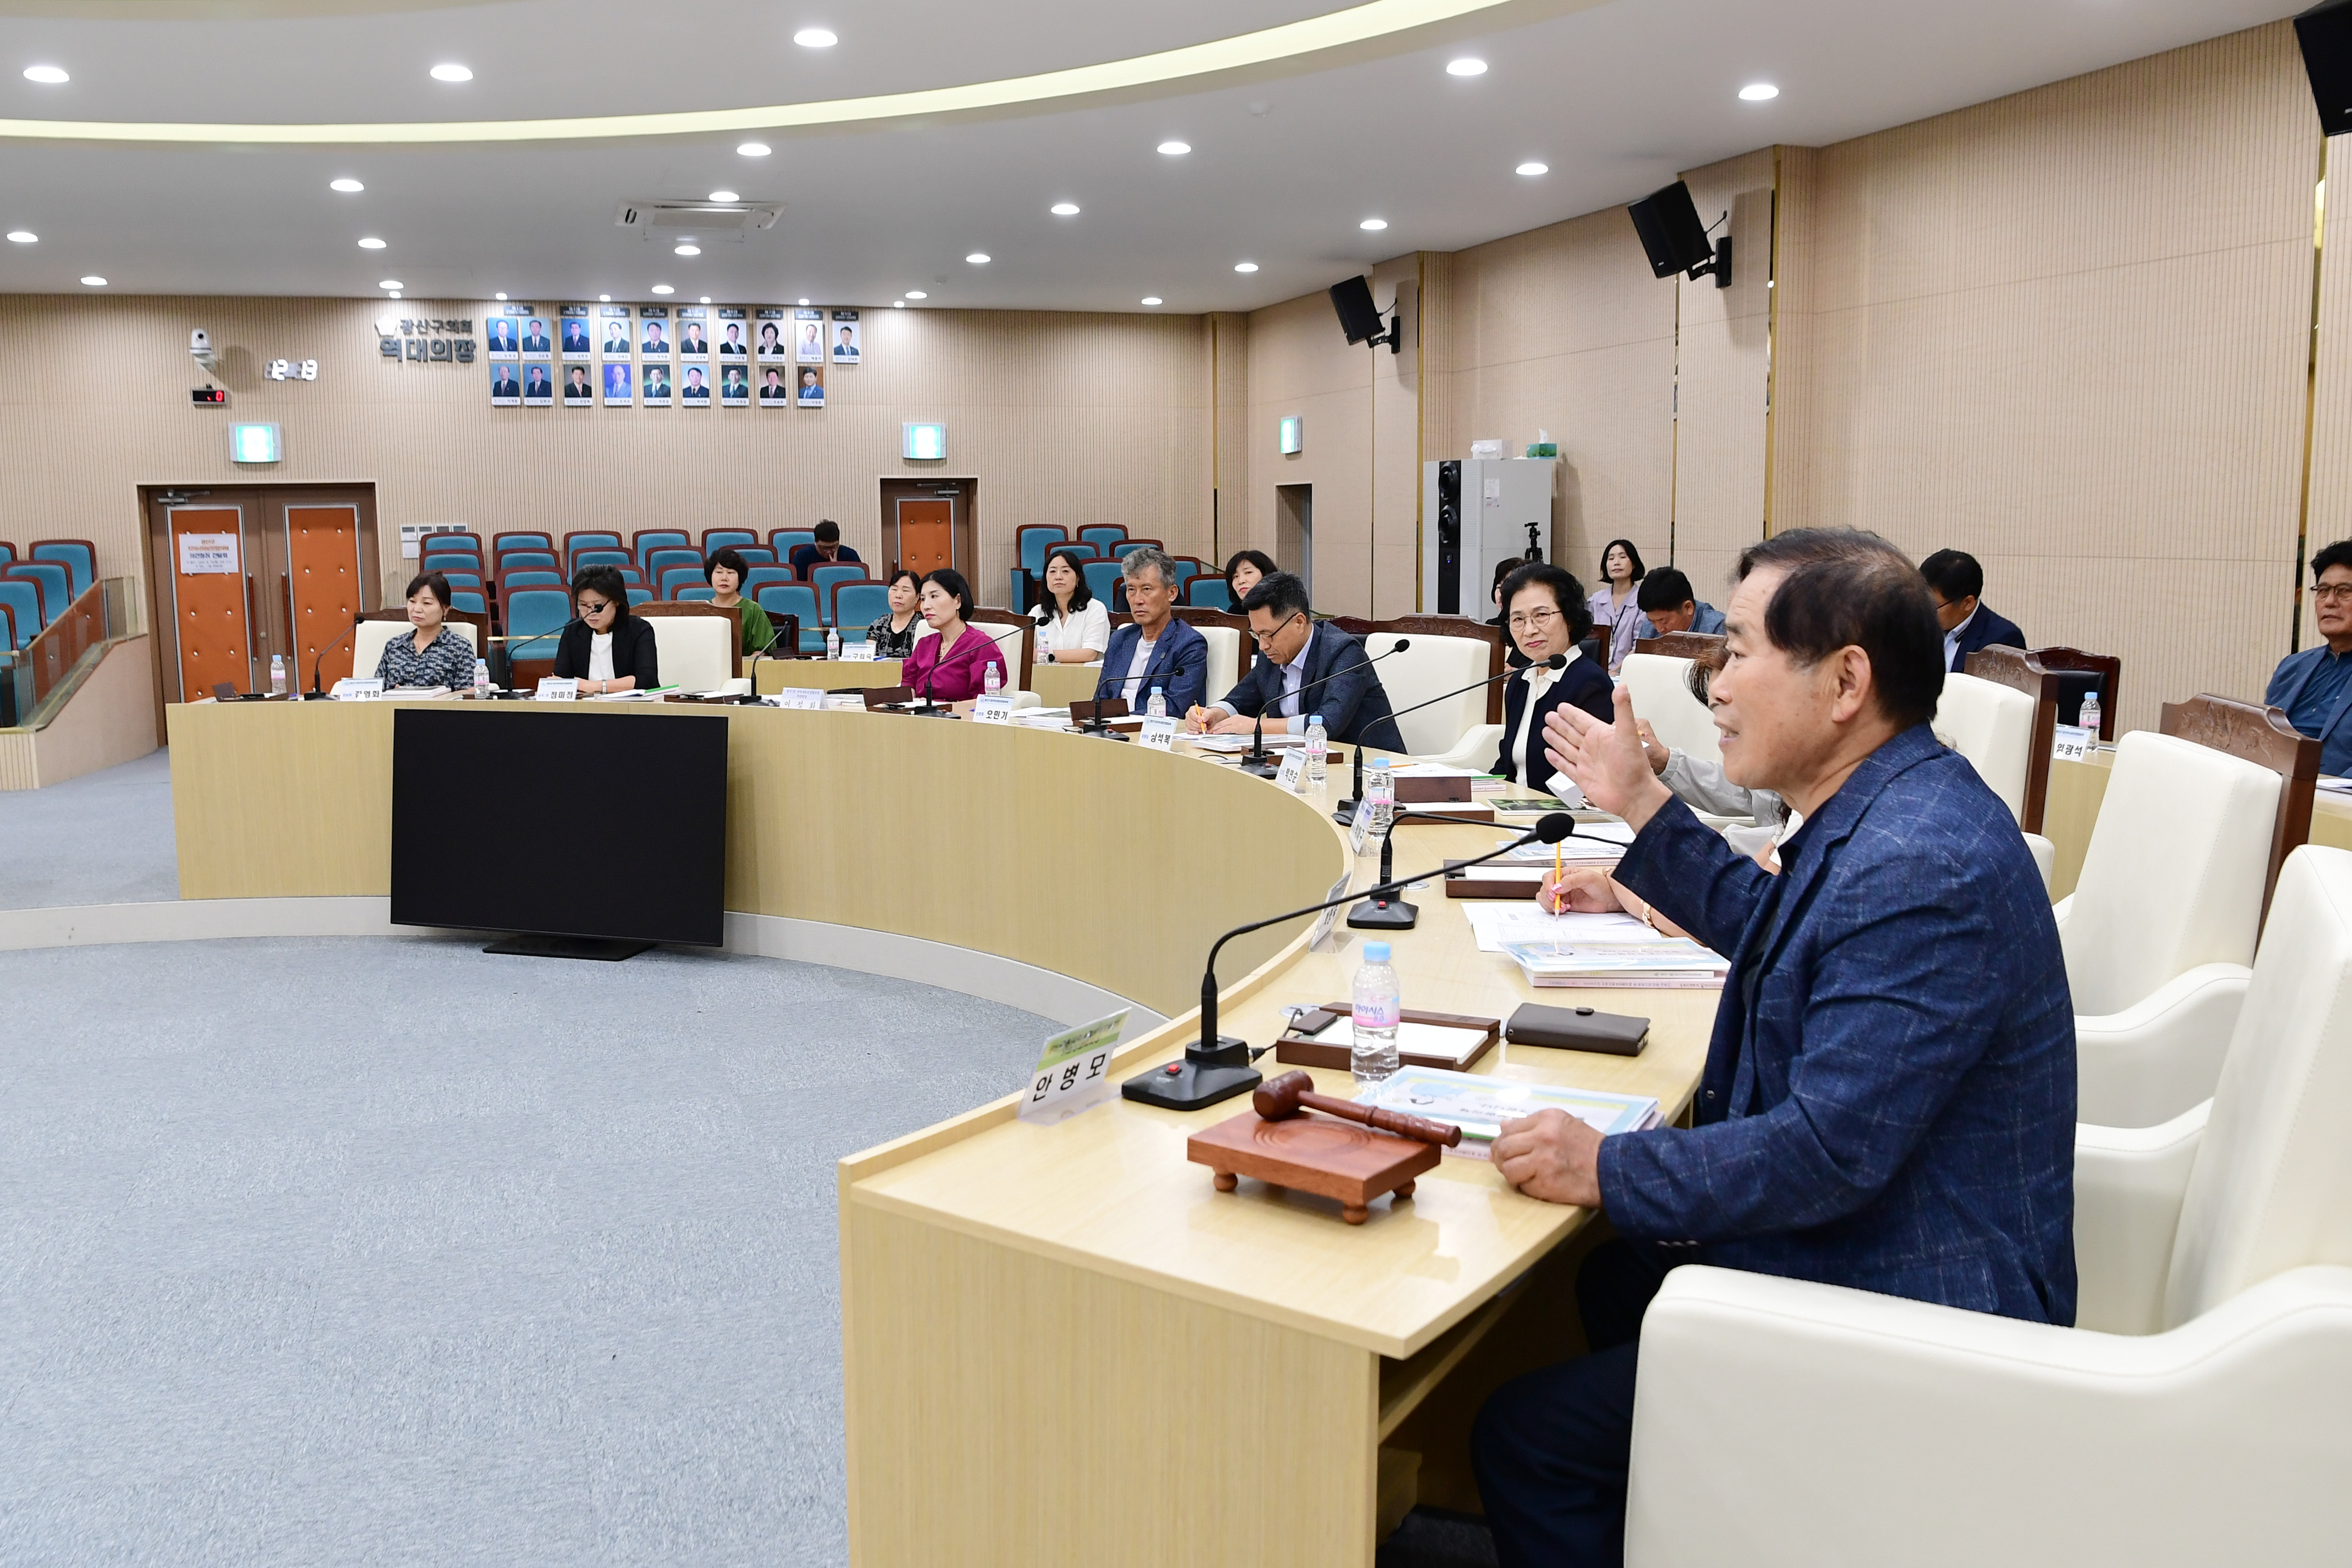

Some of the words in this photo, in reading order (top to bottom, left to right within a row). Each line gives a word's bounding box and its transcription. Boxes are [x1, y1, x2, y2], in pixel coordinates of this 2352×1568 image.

[380, 339, 476, 363] 역대의장
[985, 710, 1008, 721] 오민기
[1150, 732, 1171, 746] 상석복
[1032, 1052, 1107, 1102] 안병모
